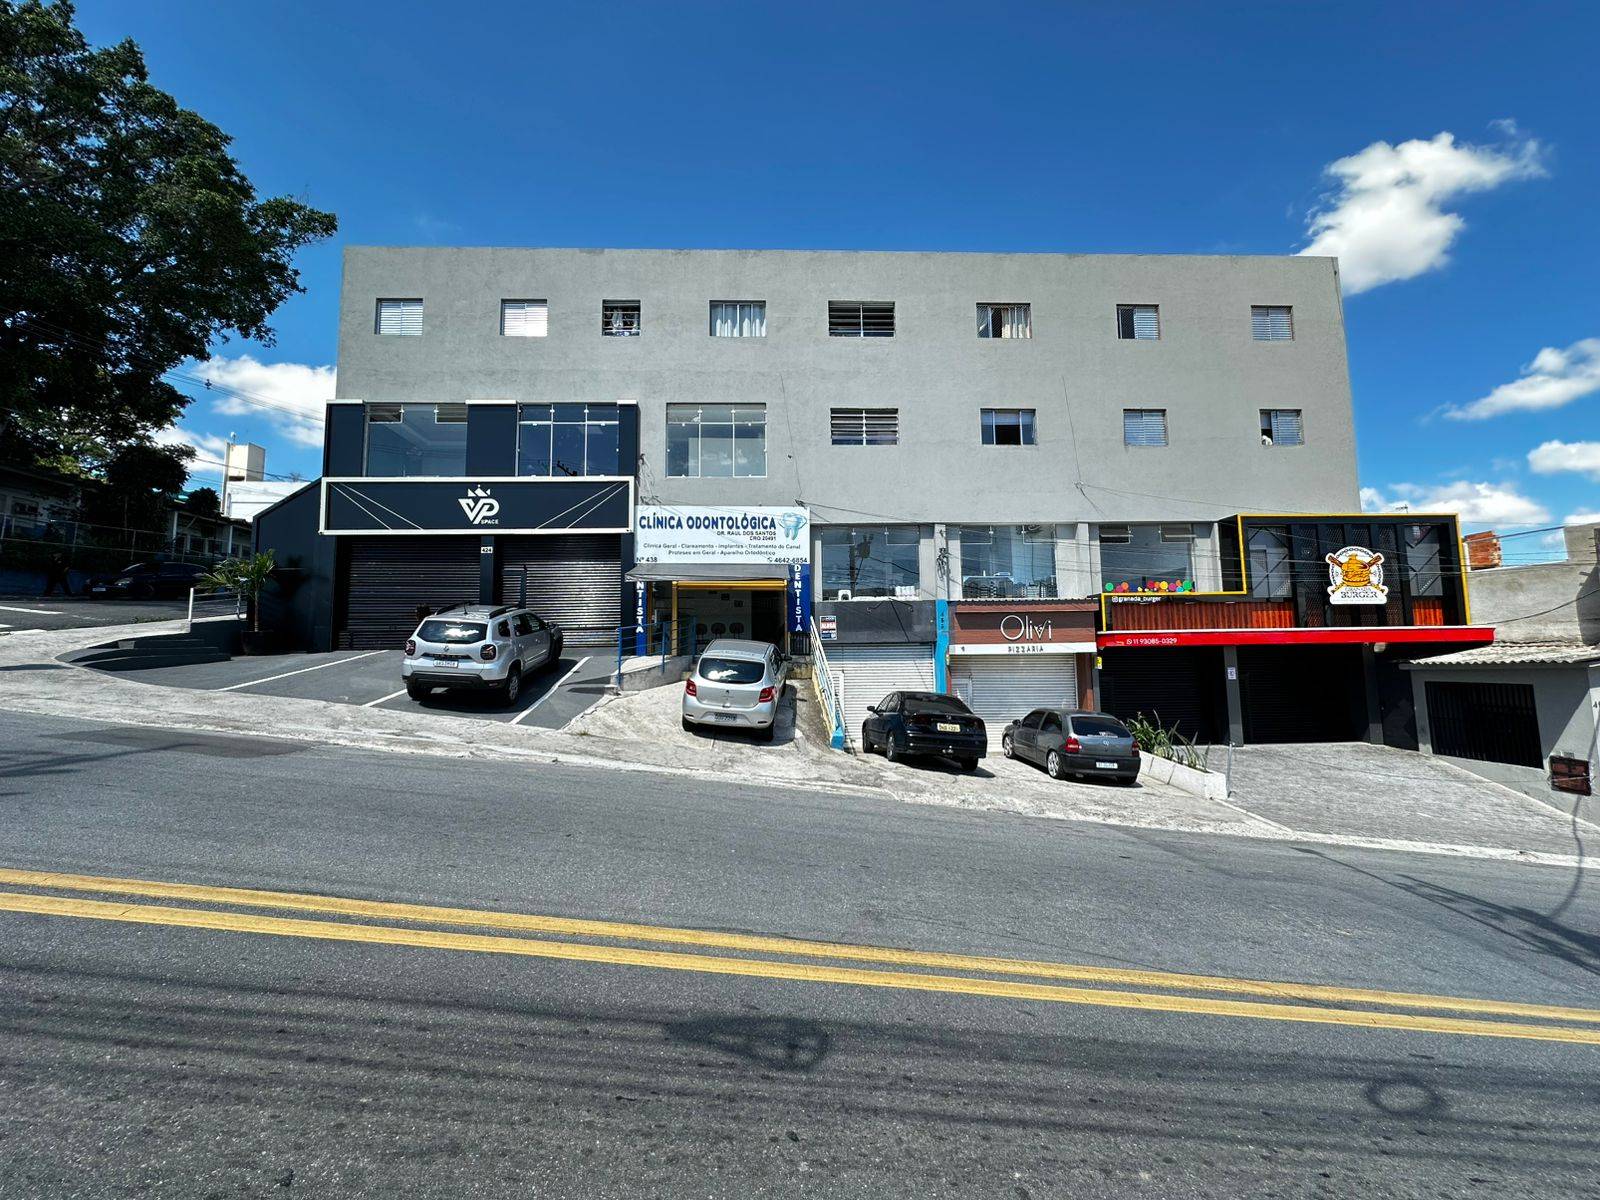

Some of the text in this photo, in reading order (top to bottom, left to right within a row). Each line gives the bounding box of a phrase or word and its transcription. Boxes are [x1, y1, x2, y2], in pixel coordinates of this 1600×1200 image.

[639, 512, 776, 529] CLÍNICA ODONTOLÓGICA
[793, 564, 803, 632] DENTISTA
[1340, 591, 1378, 599] BURGER
[1000, 614, 1052, 641] Olivi
[1008, 645, 1045, 653] PIZZARIA
